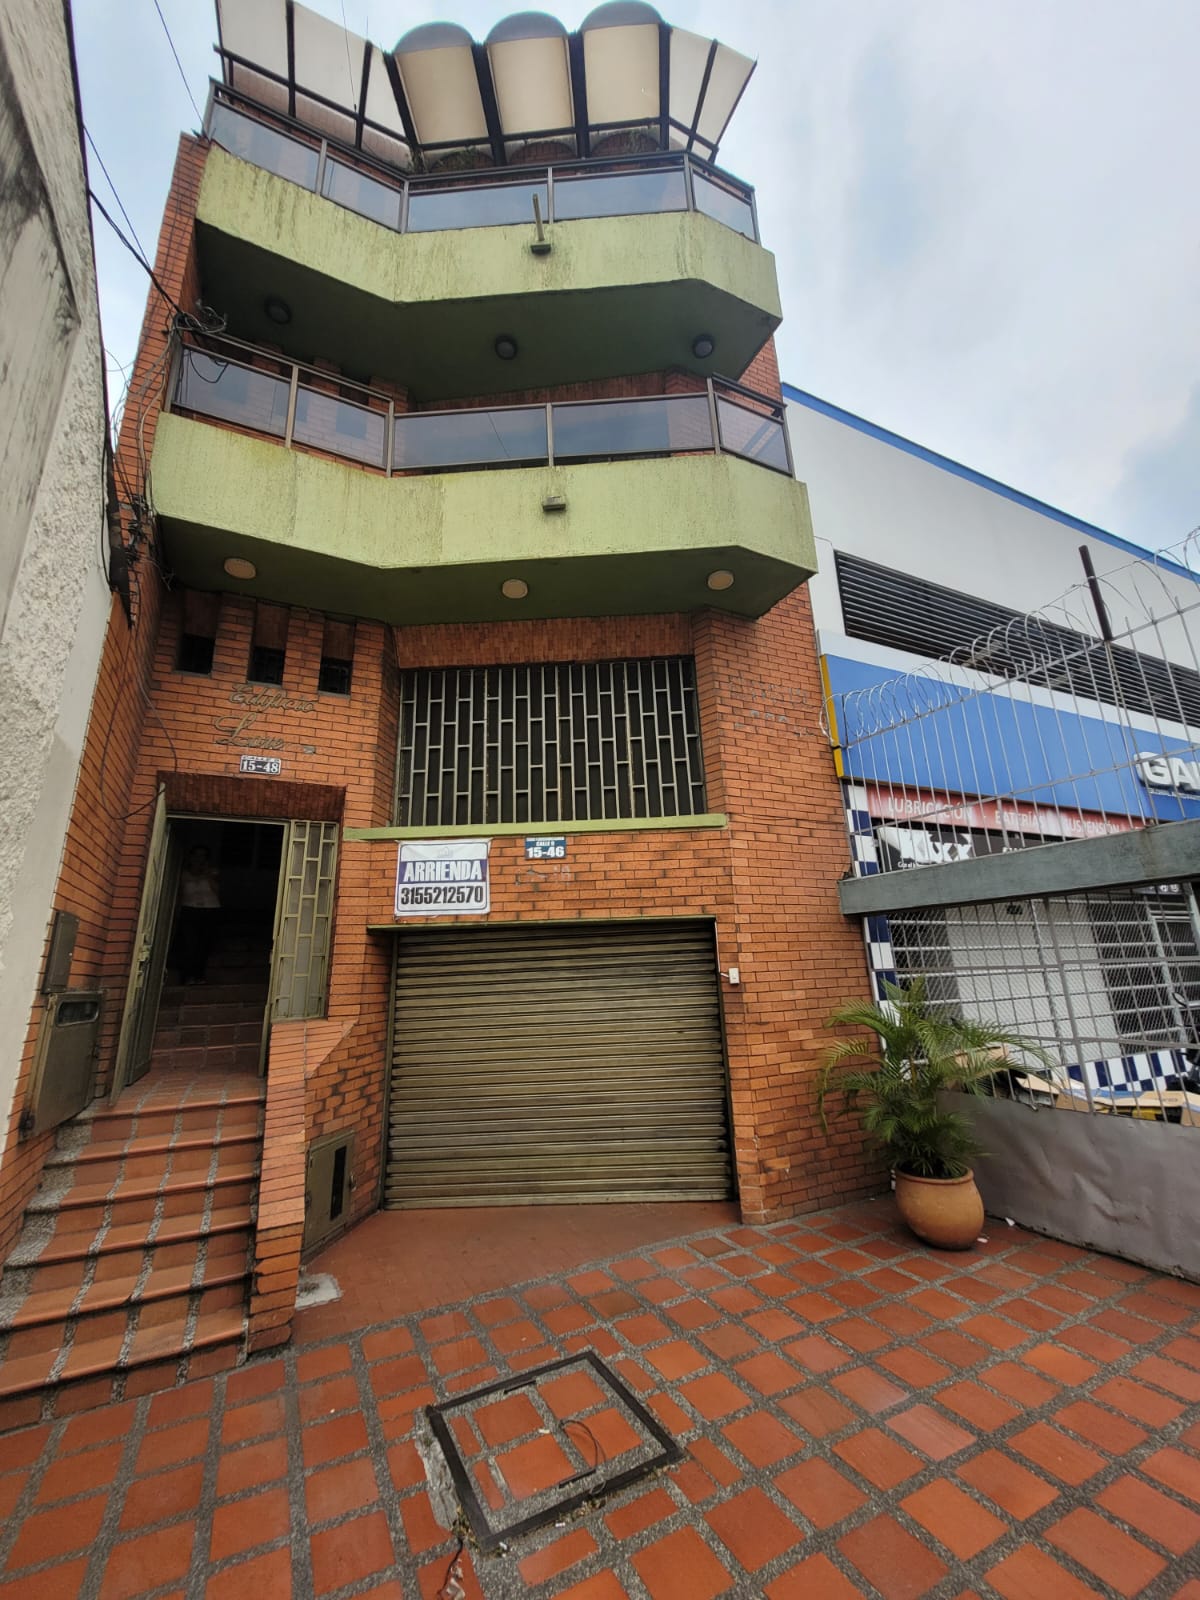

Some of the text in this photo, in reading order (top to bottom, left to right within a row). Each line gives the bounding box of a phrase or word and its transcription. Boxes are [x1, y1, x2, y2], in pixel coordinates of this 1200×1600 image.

[229, 683, 315, 713] Edificio
[242, 760, 279, 773] 15-48
[887, 797, 973, 821] LUBRICACIÓN
[526, 846, 565, 858] 15-46
[403, 860, 483, 882] ARRIENDA
[400, 885, 484, 905] 3155212570
